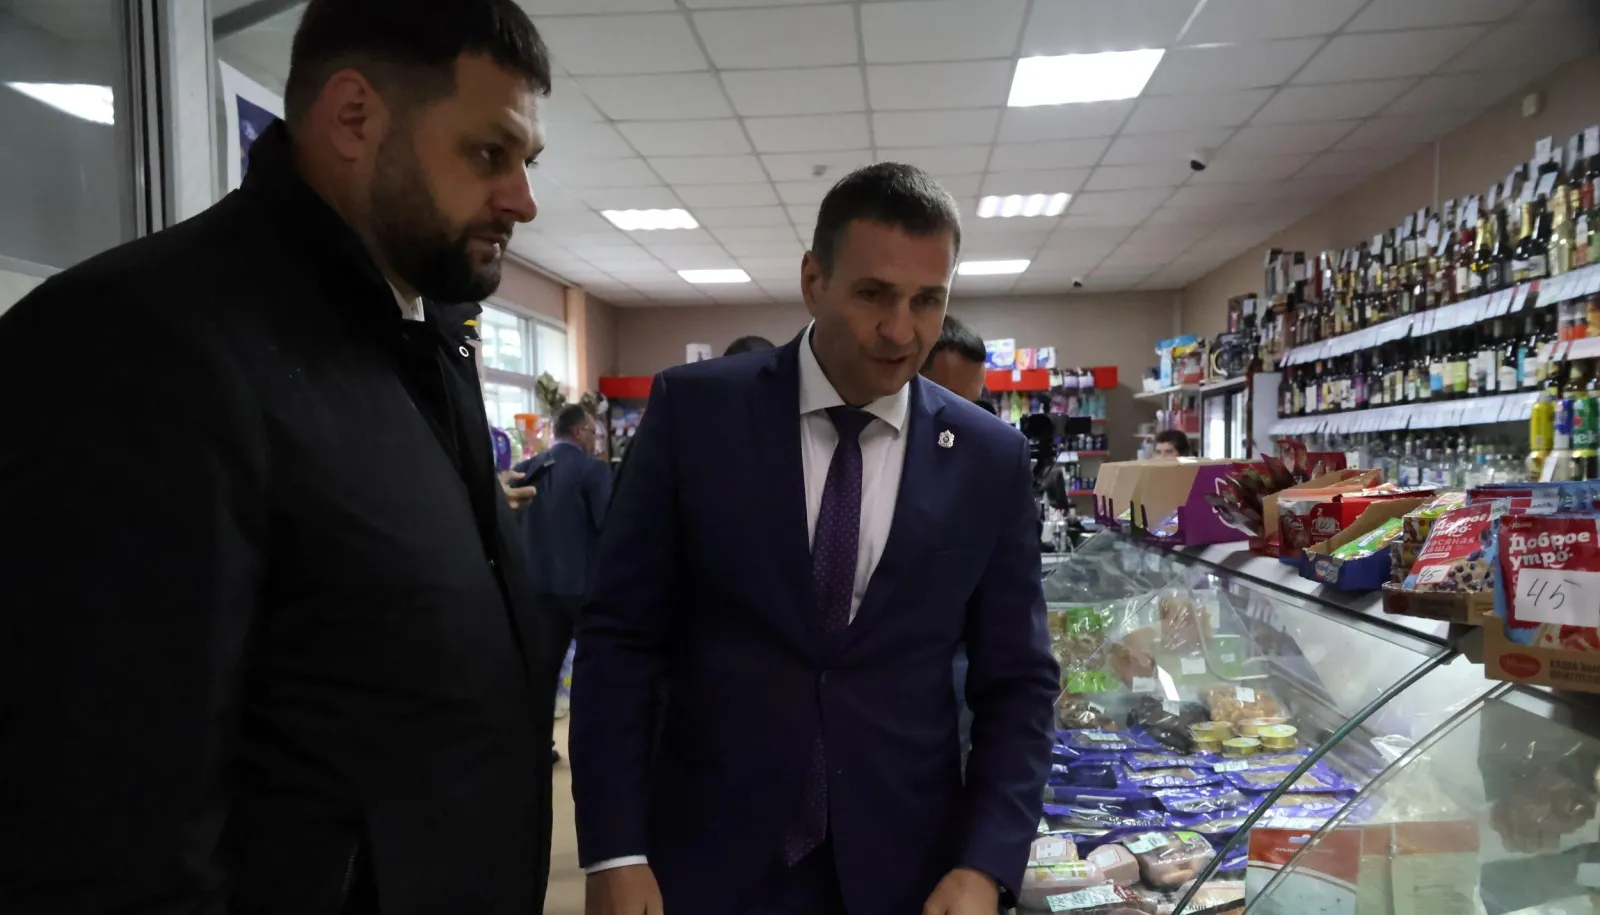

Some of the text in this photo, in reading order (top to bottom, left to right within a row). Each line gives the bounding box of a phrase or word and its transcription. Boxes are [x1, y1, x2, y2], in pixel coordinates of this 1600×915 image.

[1508, 531, 1591, 554] Доброе
[1508, 549, 1570, 571] утро
[1526, 578, 1582, 610] 45
